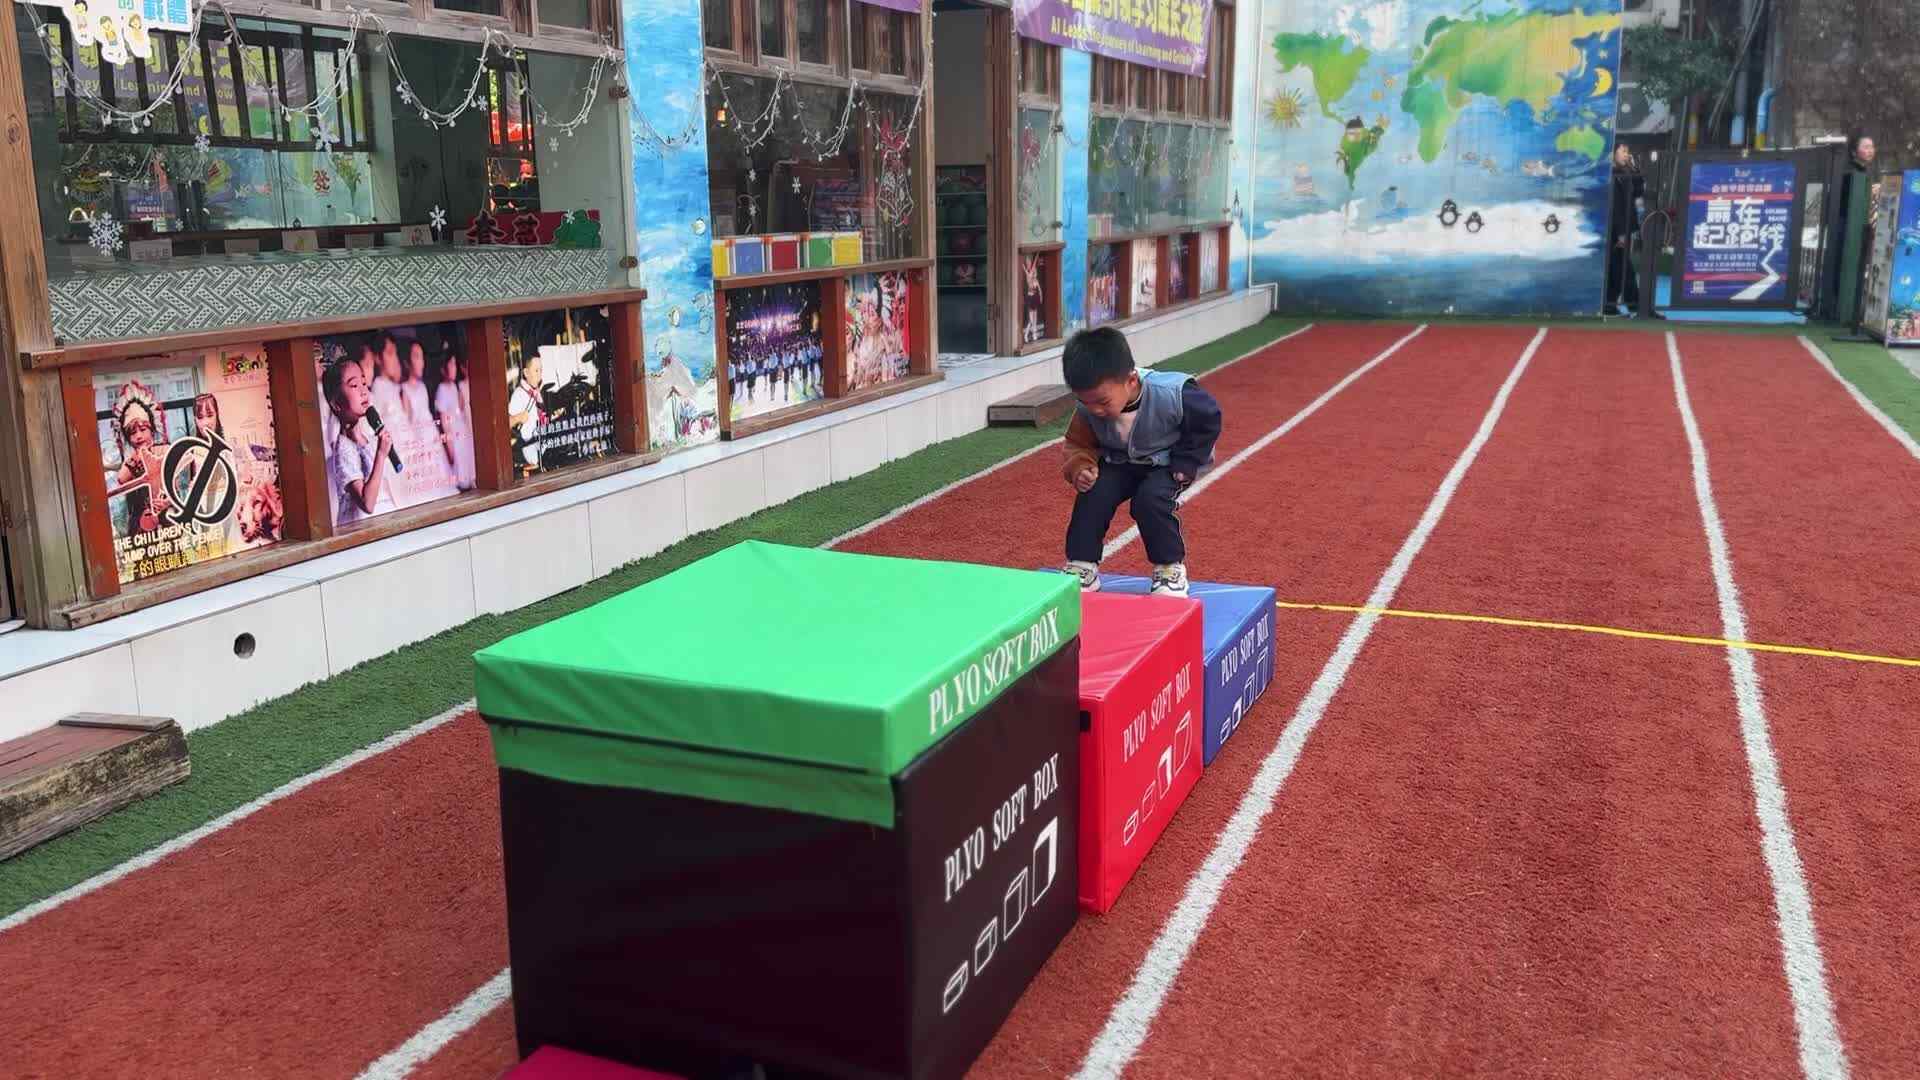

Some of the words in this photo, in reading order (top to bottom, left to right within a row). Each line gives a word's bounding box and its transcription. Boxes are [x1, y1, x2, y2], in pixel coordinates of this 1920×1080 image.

[1693, 222, 1786, 251] 起跑线
[1706, 196, 1765, 224] 赢在
[147, 542, 172, 558] OVER
[174, 537, 192, 554] THE
[929, 663, 980, 735] PLYO
[984, 630, 1027, 695] SOFT
[1029, 606, 1059, 664] BOX
[1221, 647, 1238, 688] PLYO
[1240, 628, 1255, 664] SOFT
[1256, 613, 1269, 647] BOX
[1123, 709, 1146, 763] PLYO
[1151, 681, 1172, 730] SOFT
[1175, 661, 1191, 704] BOX
[945, 826, 985, 903] PLYO
[993, 784, 1027, 851] SOFT
[1034, 752, 1059, 810] BOX
